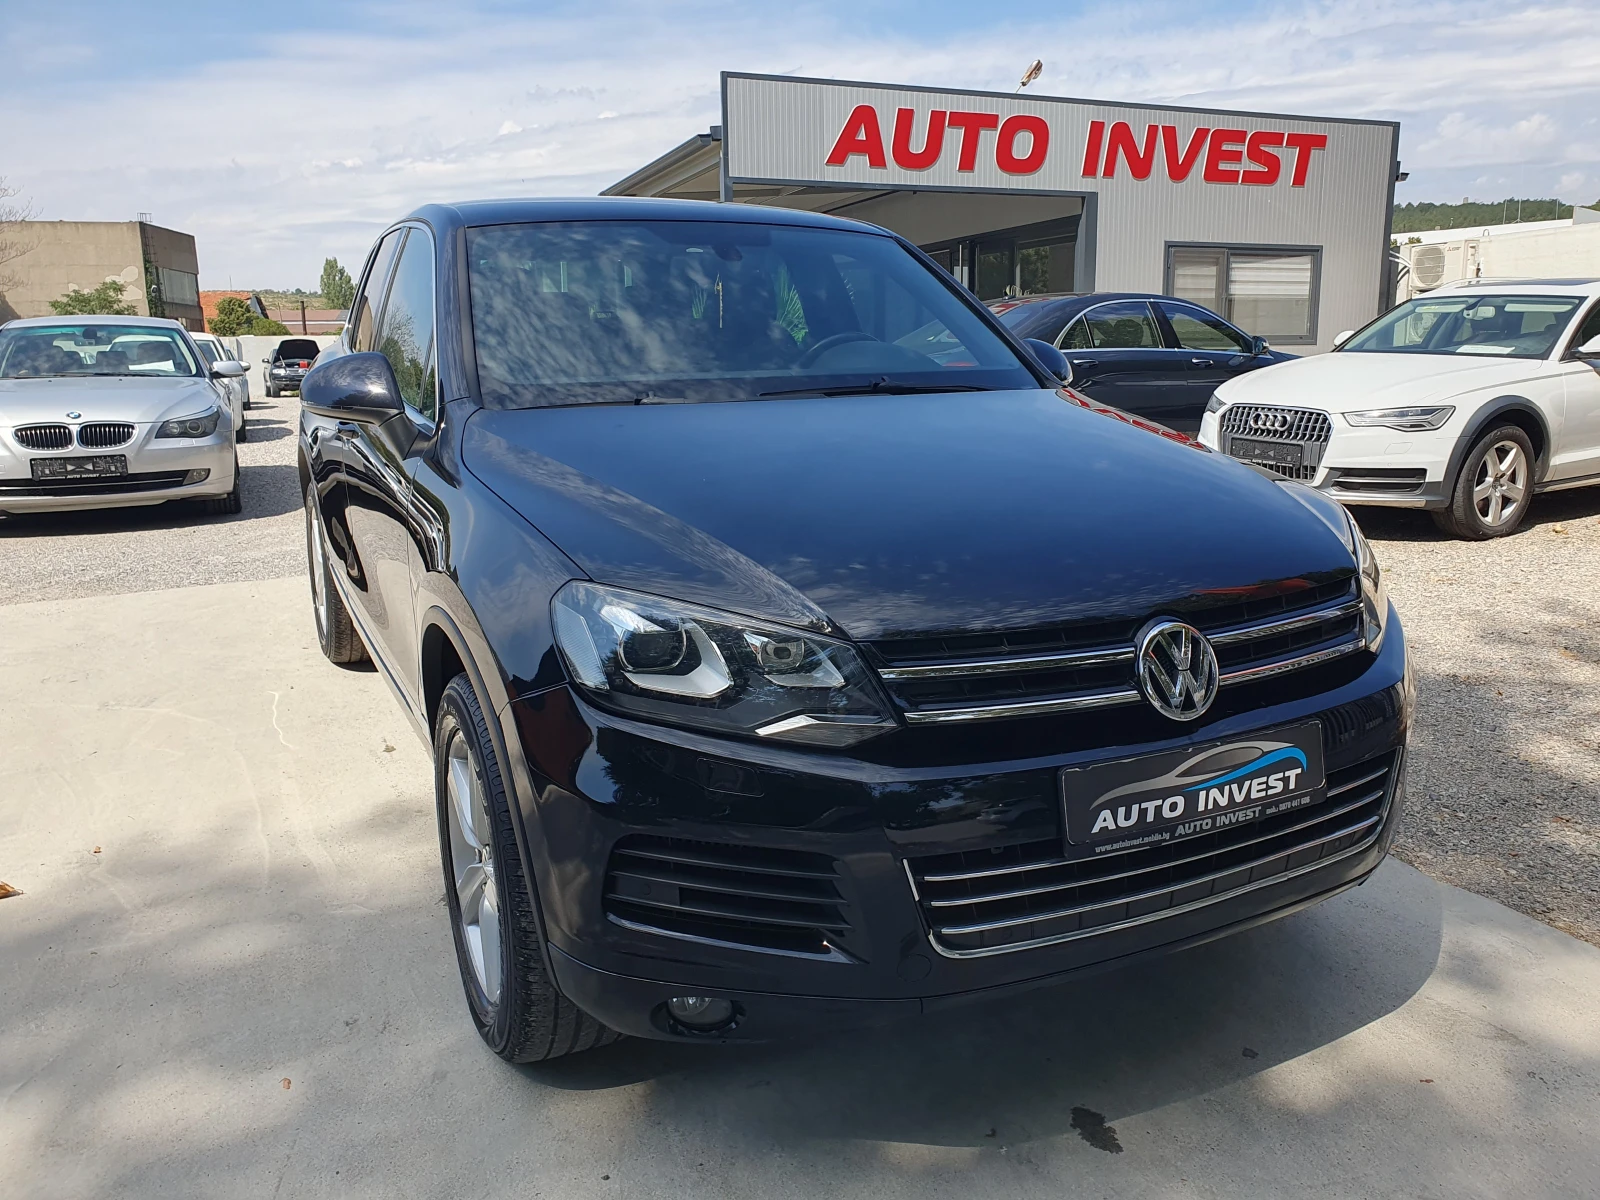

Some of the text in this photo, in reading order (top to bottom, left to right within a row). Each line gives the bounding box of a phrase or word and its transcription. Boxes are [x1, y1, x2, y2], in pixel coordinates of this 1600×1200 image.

[825, 104, 1327, 187] AUTO INVEST
[1091, 767, 1302, 834] AUTO INVEST
[1174, 818, 1212, 837] AUTO
[1215, 806, 1262, 827] INVEST
